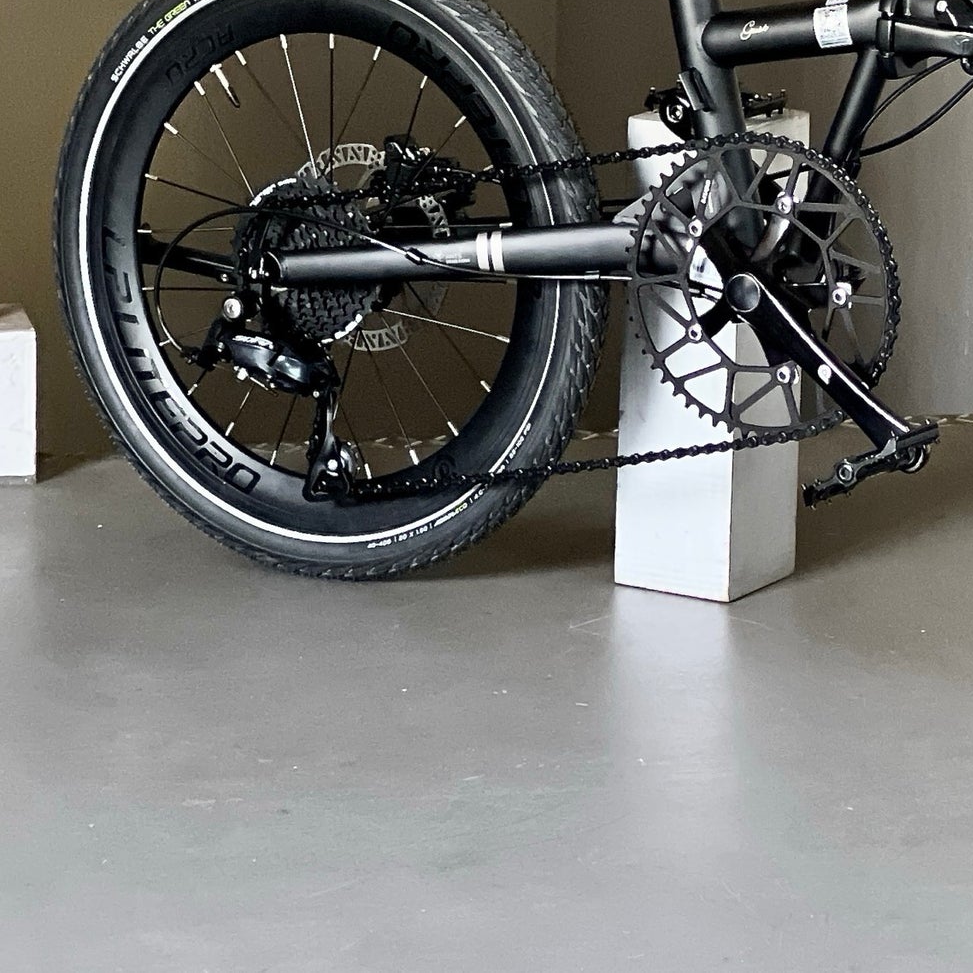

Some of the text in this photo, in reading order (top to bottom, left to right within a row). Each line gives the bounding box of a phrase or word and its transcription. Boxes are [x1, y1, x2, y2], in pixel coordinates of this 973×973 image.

[110, 35, 149, 83] SCHWALBE
[148, 18, 166, 35] THE
[164, 0, 191, 22] GREEN
